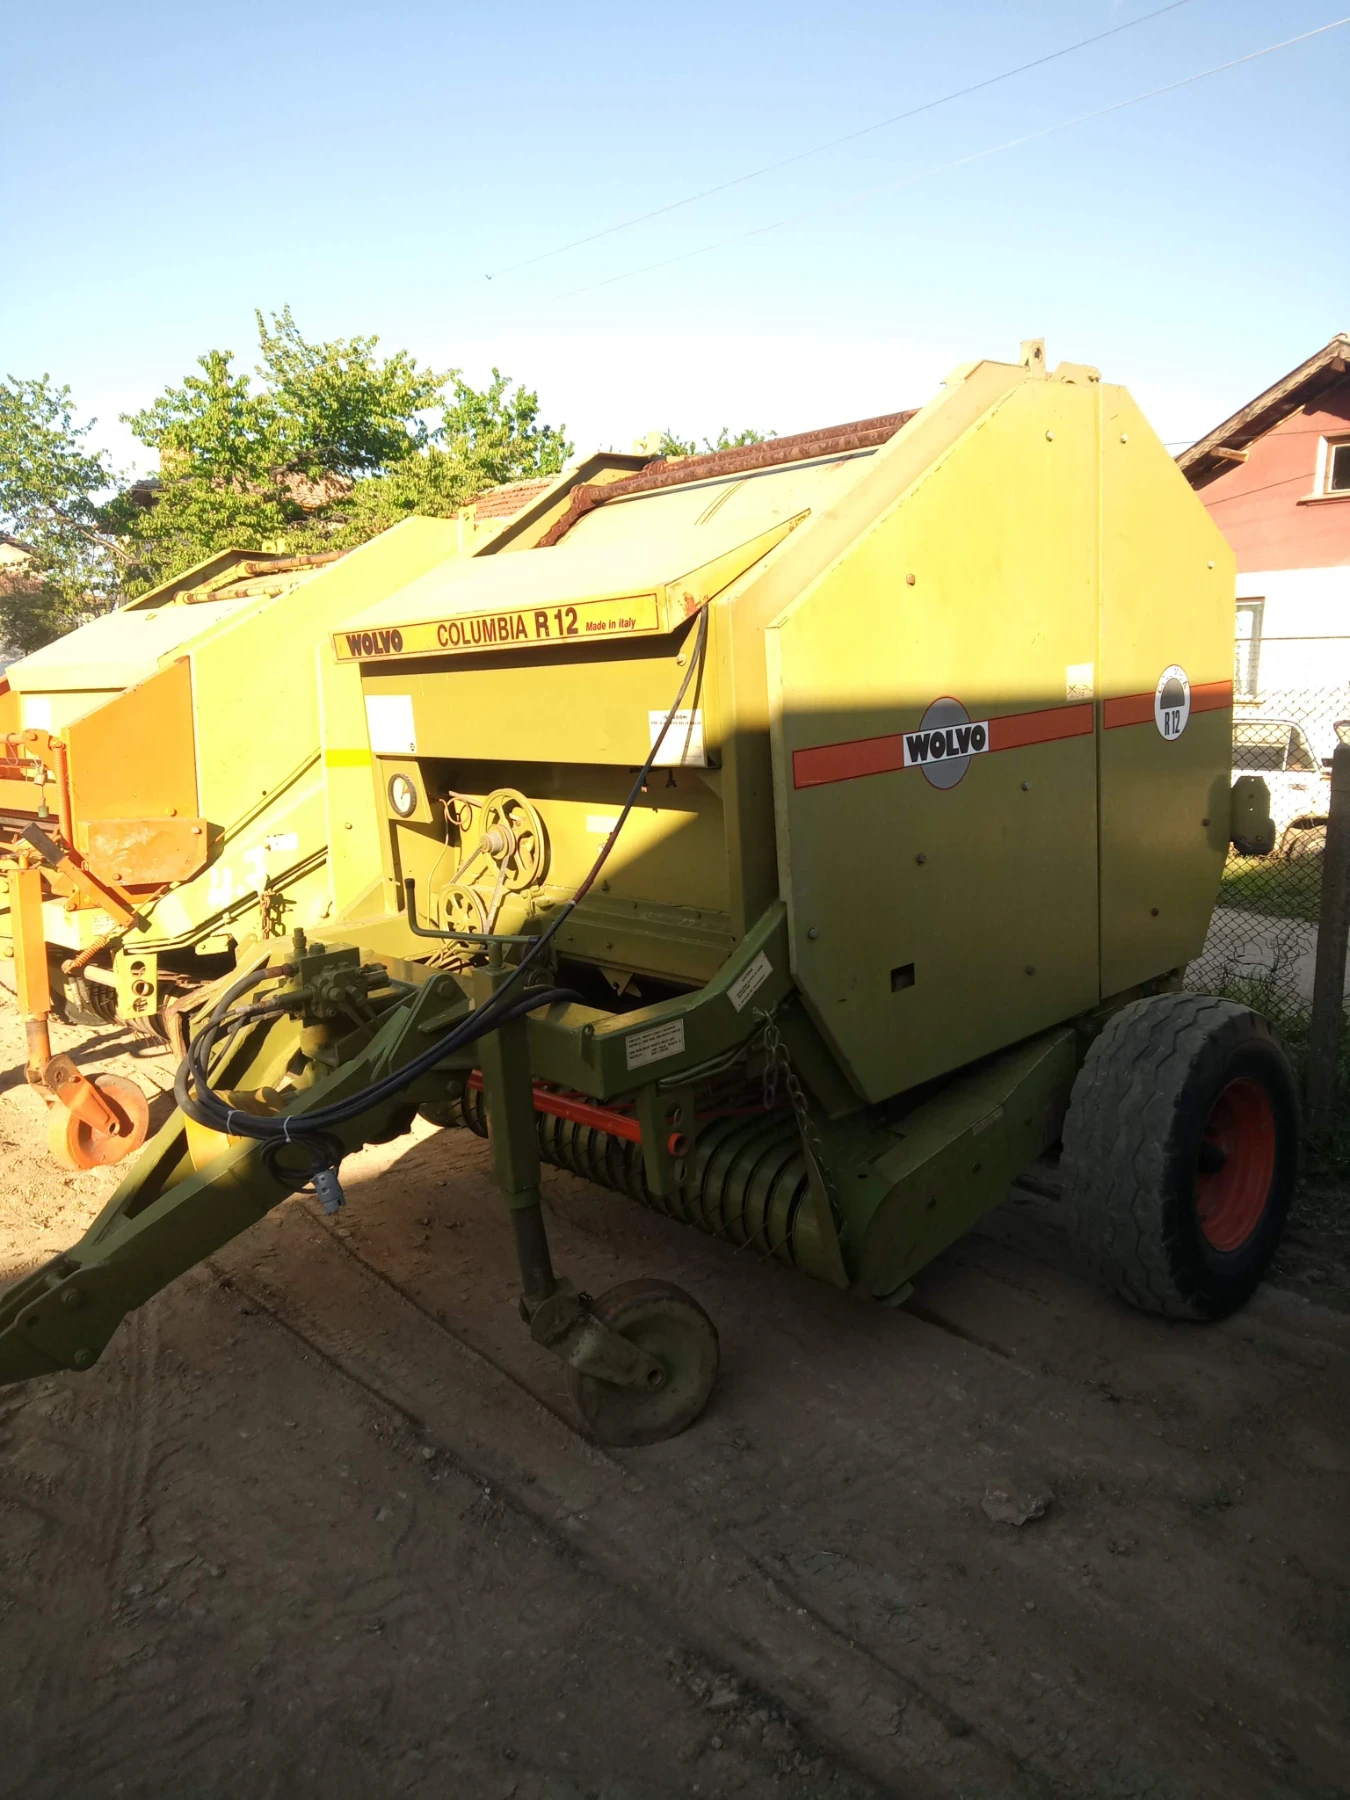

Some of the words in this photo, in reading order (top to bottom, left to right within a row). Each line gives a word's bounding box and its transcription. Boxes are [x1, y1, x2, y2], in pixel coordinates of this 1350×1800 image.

[345, 629, 403, 656] WOLVO
[437, 614, 528, 647] COLUMBIA
[534, 611, 550, 638] R
[554, 607, 578, 636] 12
[586, 620, 606, 632] Made
[608, 619, 616, 630] in
[1164, 711, 1170, 736] R
[1172, 709, 1180, 735] 12
[906, 725, 986, 763] WOLVO
